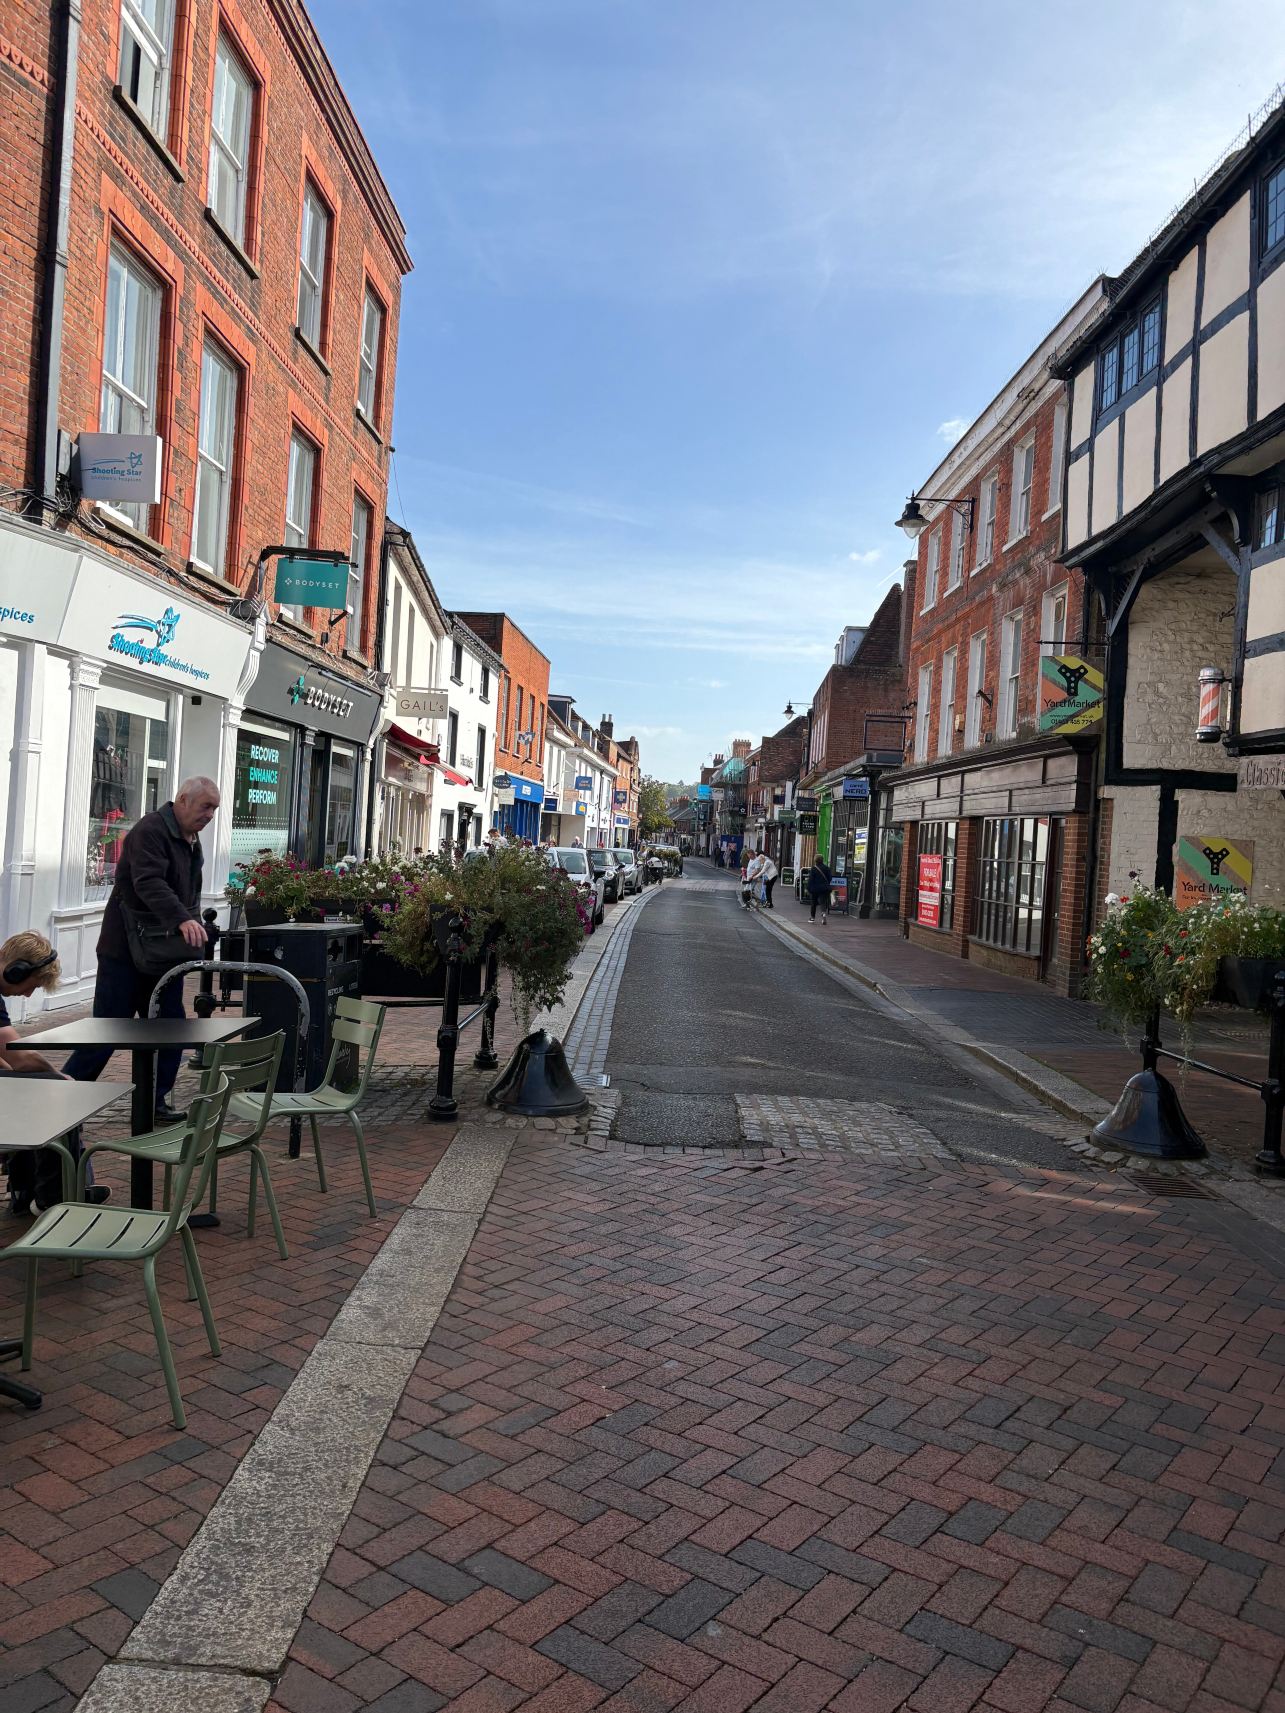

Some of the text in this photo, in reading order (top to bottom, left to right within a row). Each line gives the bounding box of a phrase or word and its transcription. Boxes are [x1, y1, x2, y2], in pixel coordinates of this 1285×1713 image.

[91, 466, 142, 476] Shooting Star
[295, 579, 340, 589] BODYSET
[306, 686, 354, 717] BODYSET
[400, 699, 444, 712] GAIL's
[1043, 698, 1101, 709] Yard Market
[250, 745, 279, 763] RECOVER
[249, 766, 278, 784] ENHANCE
[248, 788, 277, 805] PERFORM
[1182, 882, 1206, 893] Yard
